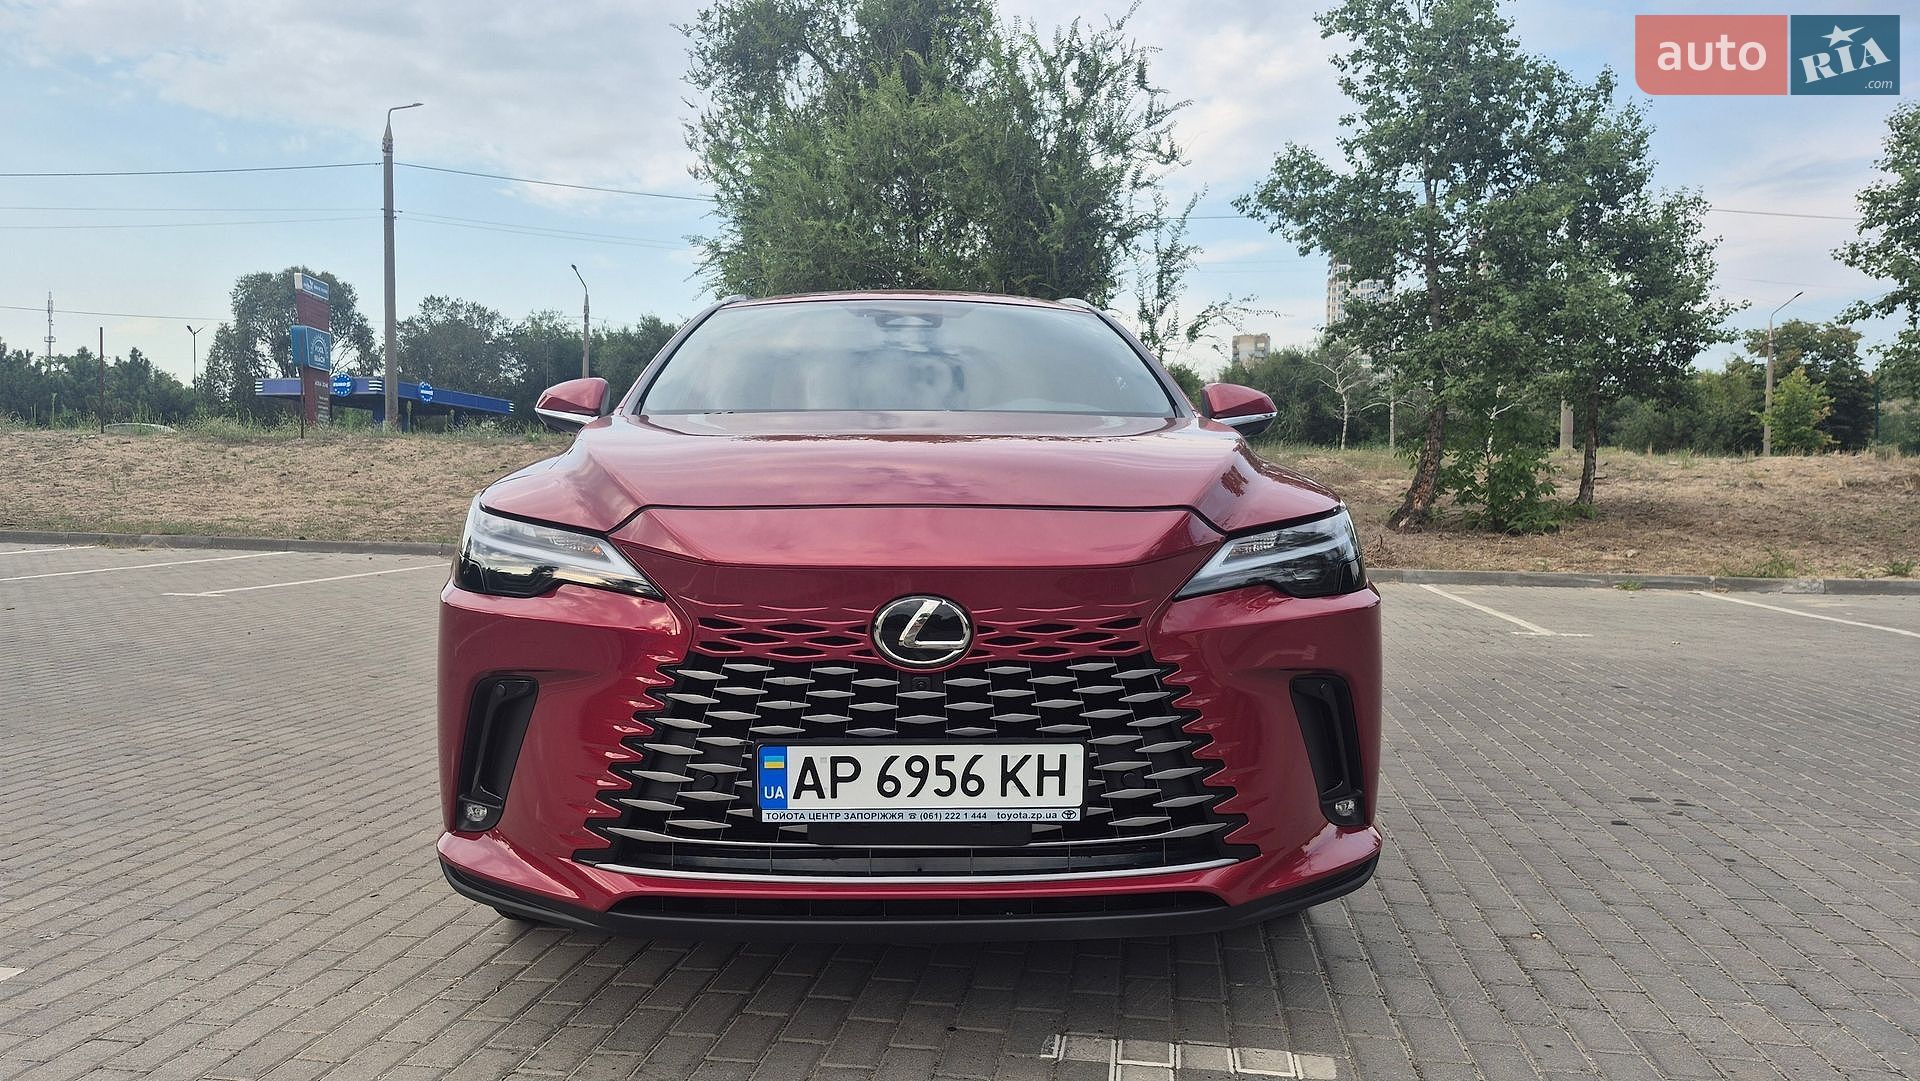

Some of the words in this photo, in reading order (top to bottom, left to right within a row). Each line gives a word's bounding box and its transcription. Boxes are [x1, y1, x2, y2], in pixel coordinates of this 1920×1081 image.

[792, 755, 862, 800] AP
[877, 754, 985, 799] 6956
[1001, 754, 1067, 798] KH
[764, 786, 785, 800] UA
[766, 811, 805, 821] ТОЙОТА
[808, 812, 840, 822] ЦЕНТР
[843, 812, 904, 820] ЗАПОРІЖЖЯ
[919, 811, 942, 821] (061)
[945, 812, 961, 820] 222
[963, 812, 968, 820] 1
[970, 811, 987, 820] 444
[997, 811, 1057, 821] toyota.zp.ua
